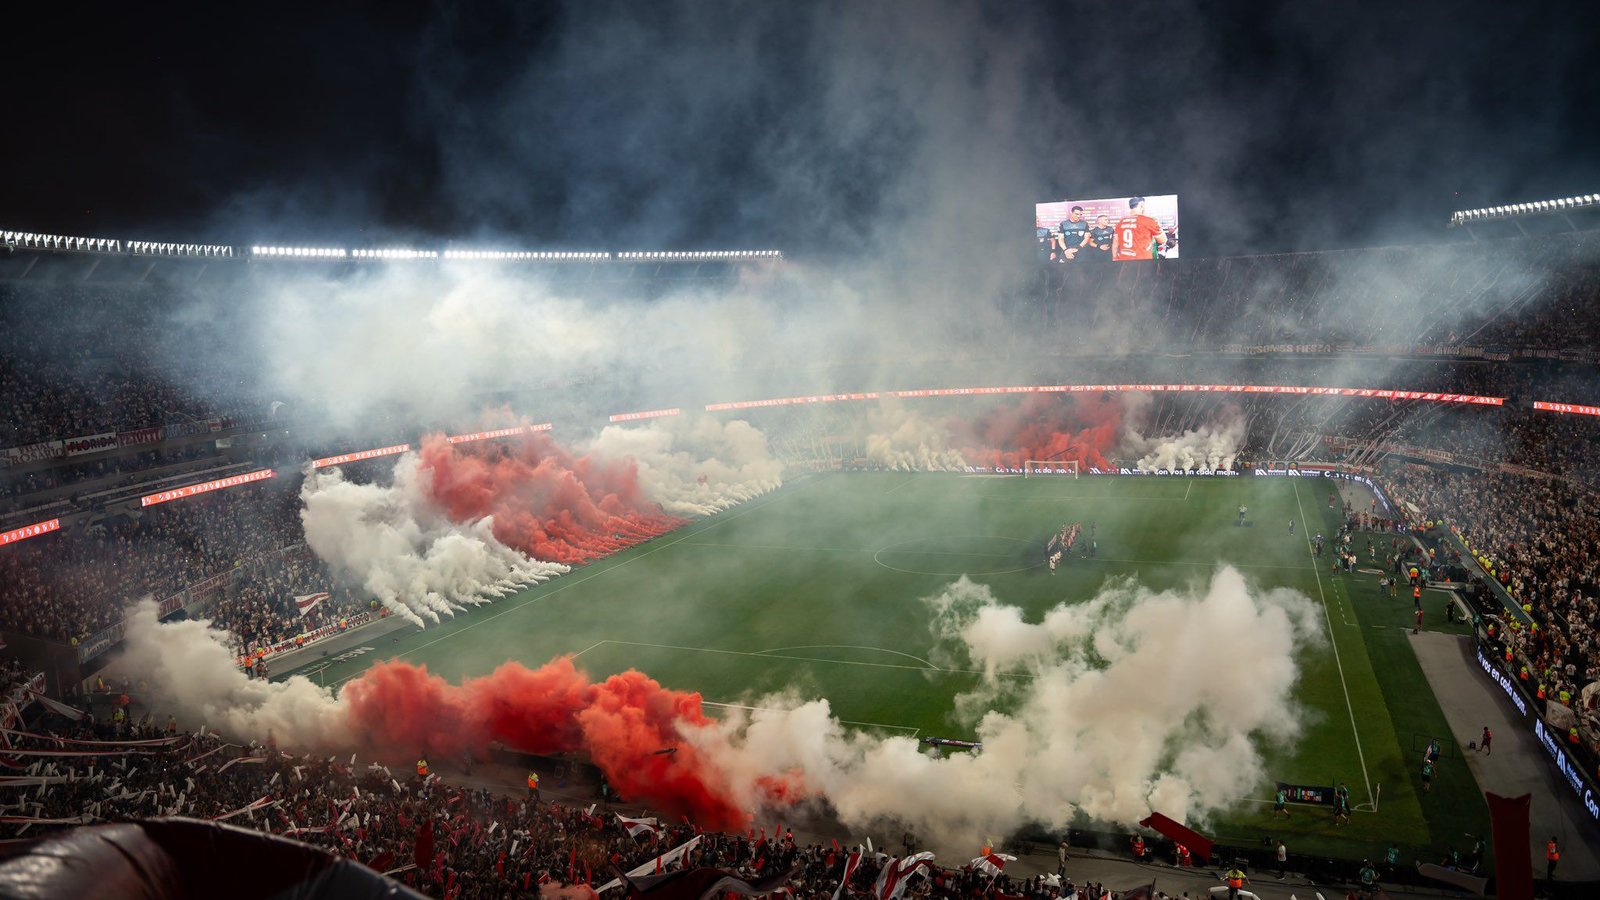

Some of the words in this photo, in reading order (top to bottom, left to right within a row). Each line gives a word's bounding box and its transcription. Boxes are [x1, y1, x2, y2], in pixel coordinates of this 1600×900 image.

[1123, 229, 1133, 249] 9
[69, 435, 115, 453] FLORIDA
[1491, 668, 1500, 682] en
[1500, 676, 1513, 697] cada
[1584, 789, 1600, 820] Con
